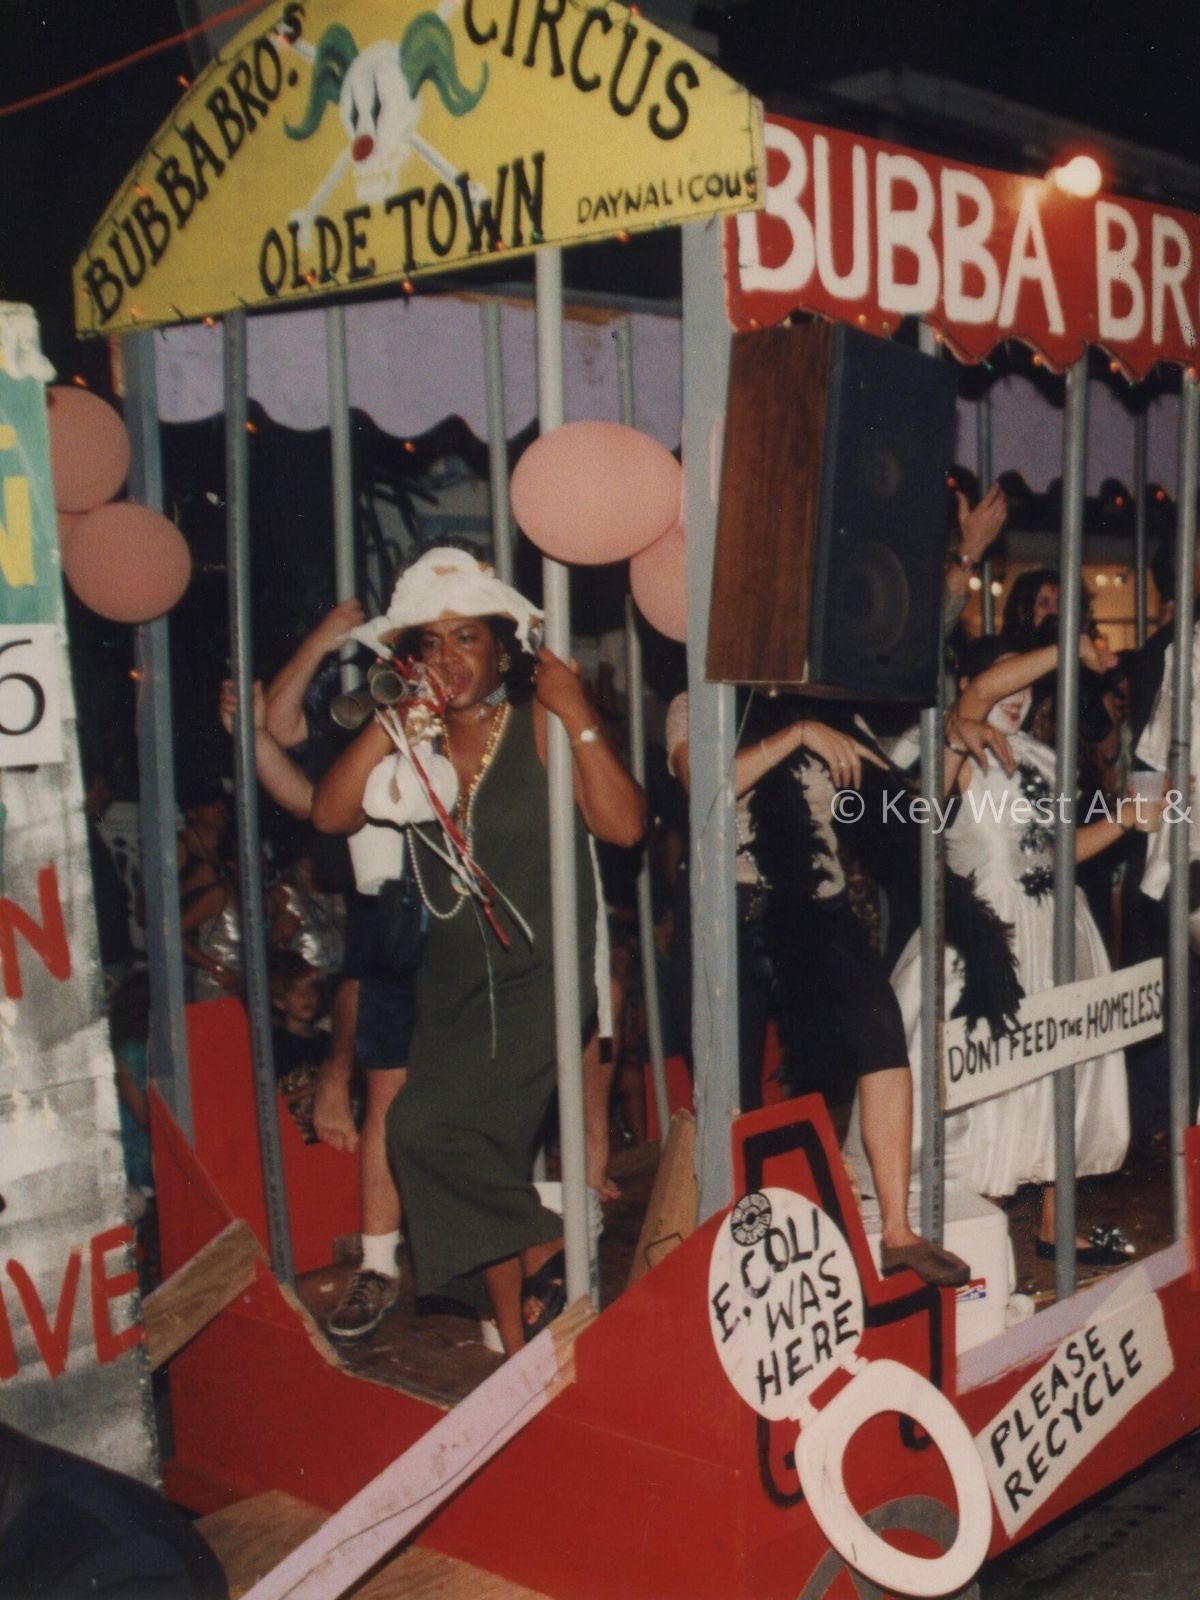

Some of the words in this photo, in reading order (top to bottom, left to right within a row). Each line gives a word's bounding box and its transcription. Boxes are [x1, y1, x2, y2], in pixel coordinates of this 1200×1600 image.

[84, 117, 227, 320] BUBBA
[258, 208, 375, 297] OLDE
[384, 150, 546, 257] TOWN
[737, 121, 1065, 335] BUBBA
[1009, 1016, 1058, 1061] FEED
[1060, 1017, 1084, 1041] THE
[1086, 980, 1163, 1040] HOMELESS
[740, 1207, 820, 1299] COLI
[766, 1250, 842, 1342] WAS
[756, 1299, 860, 1405] HERE
[988, 1325, 1107, 1468] PLEASE
[1003, 1329, 1143, 1512] RECYCLE
